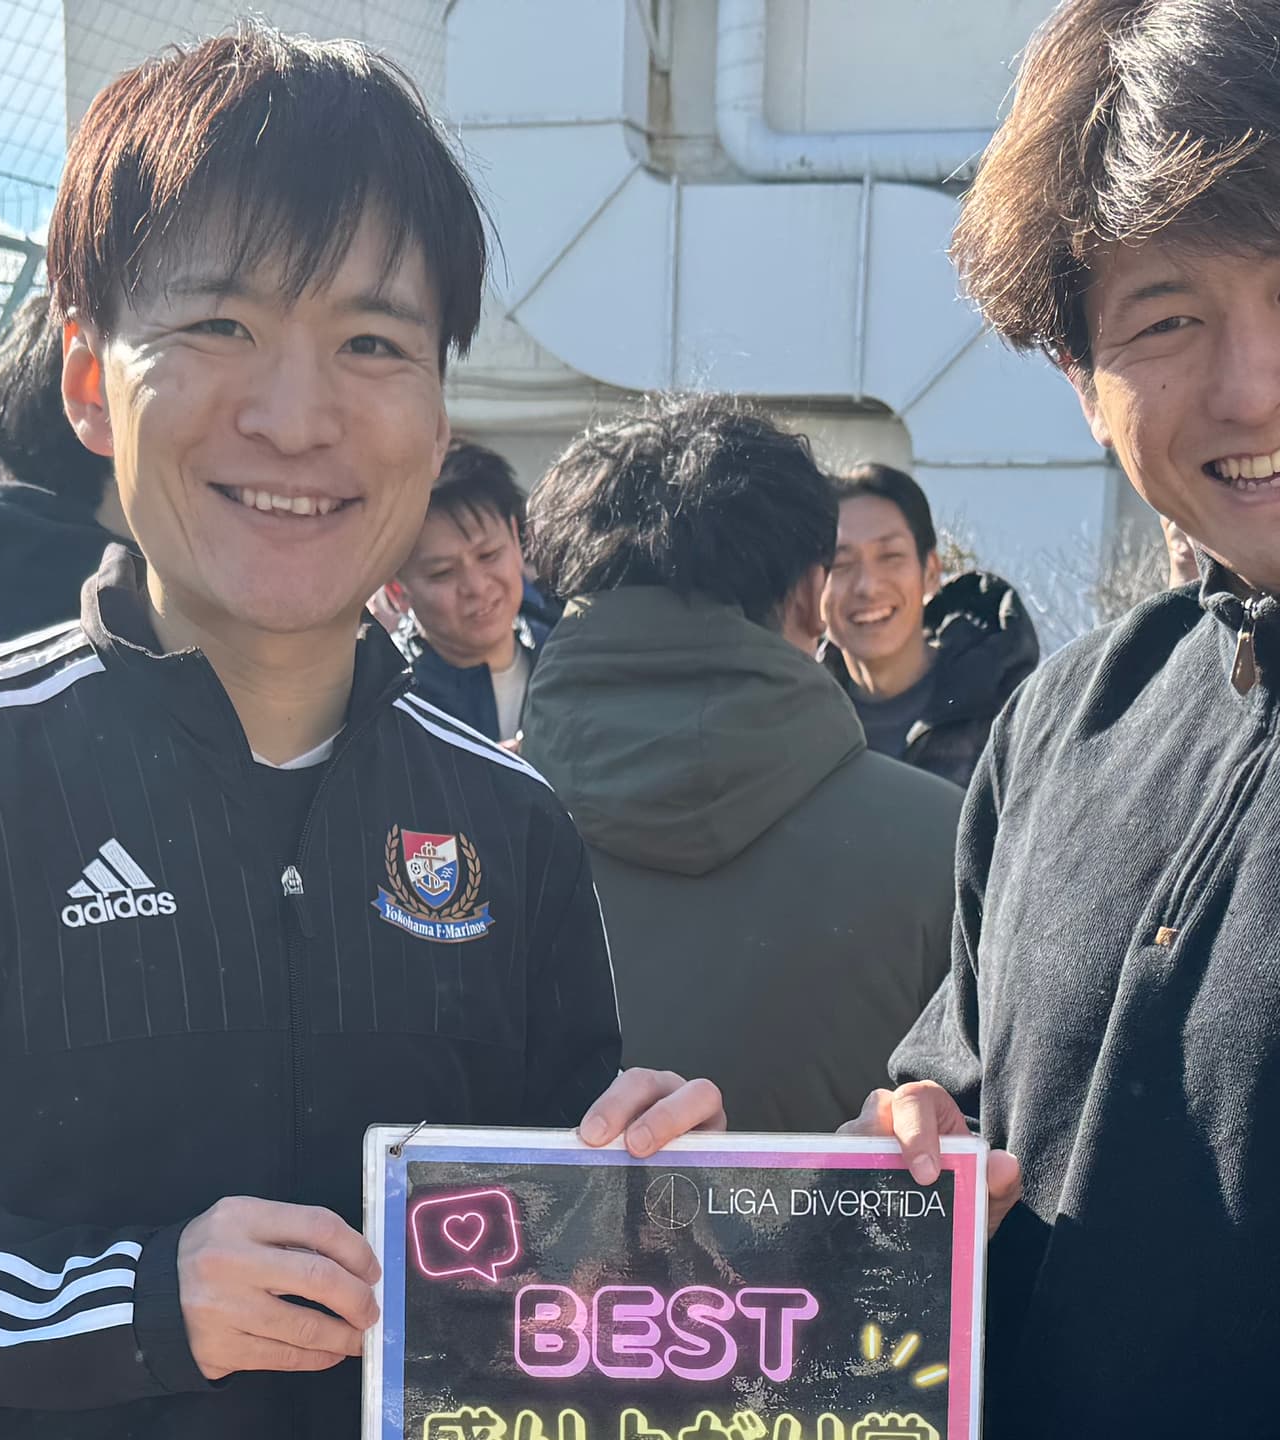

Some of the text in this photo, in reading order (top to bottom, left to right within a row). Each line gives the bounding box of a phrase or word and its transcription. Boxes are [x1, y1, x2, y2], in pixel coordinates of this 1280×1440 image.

[61, 888, 177, 928] adidas
[385, 903, 435, 937] Yokohama
[514, 1284, 821, 1383] BEST
